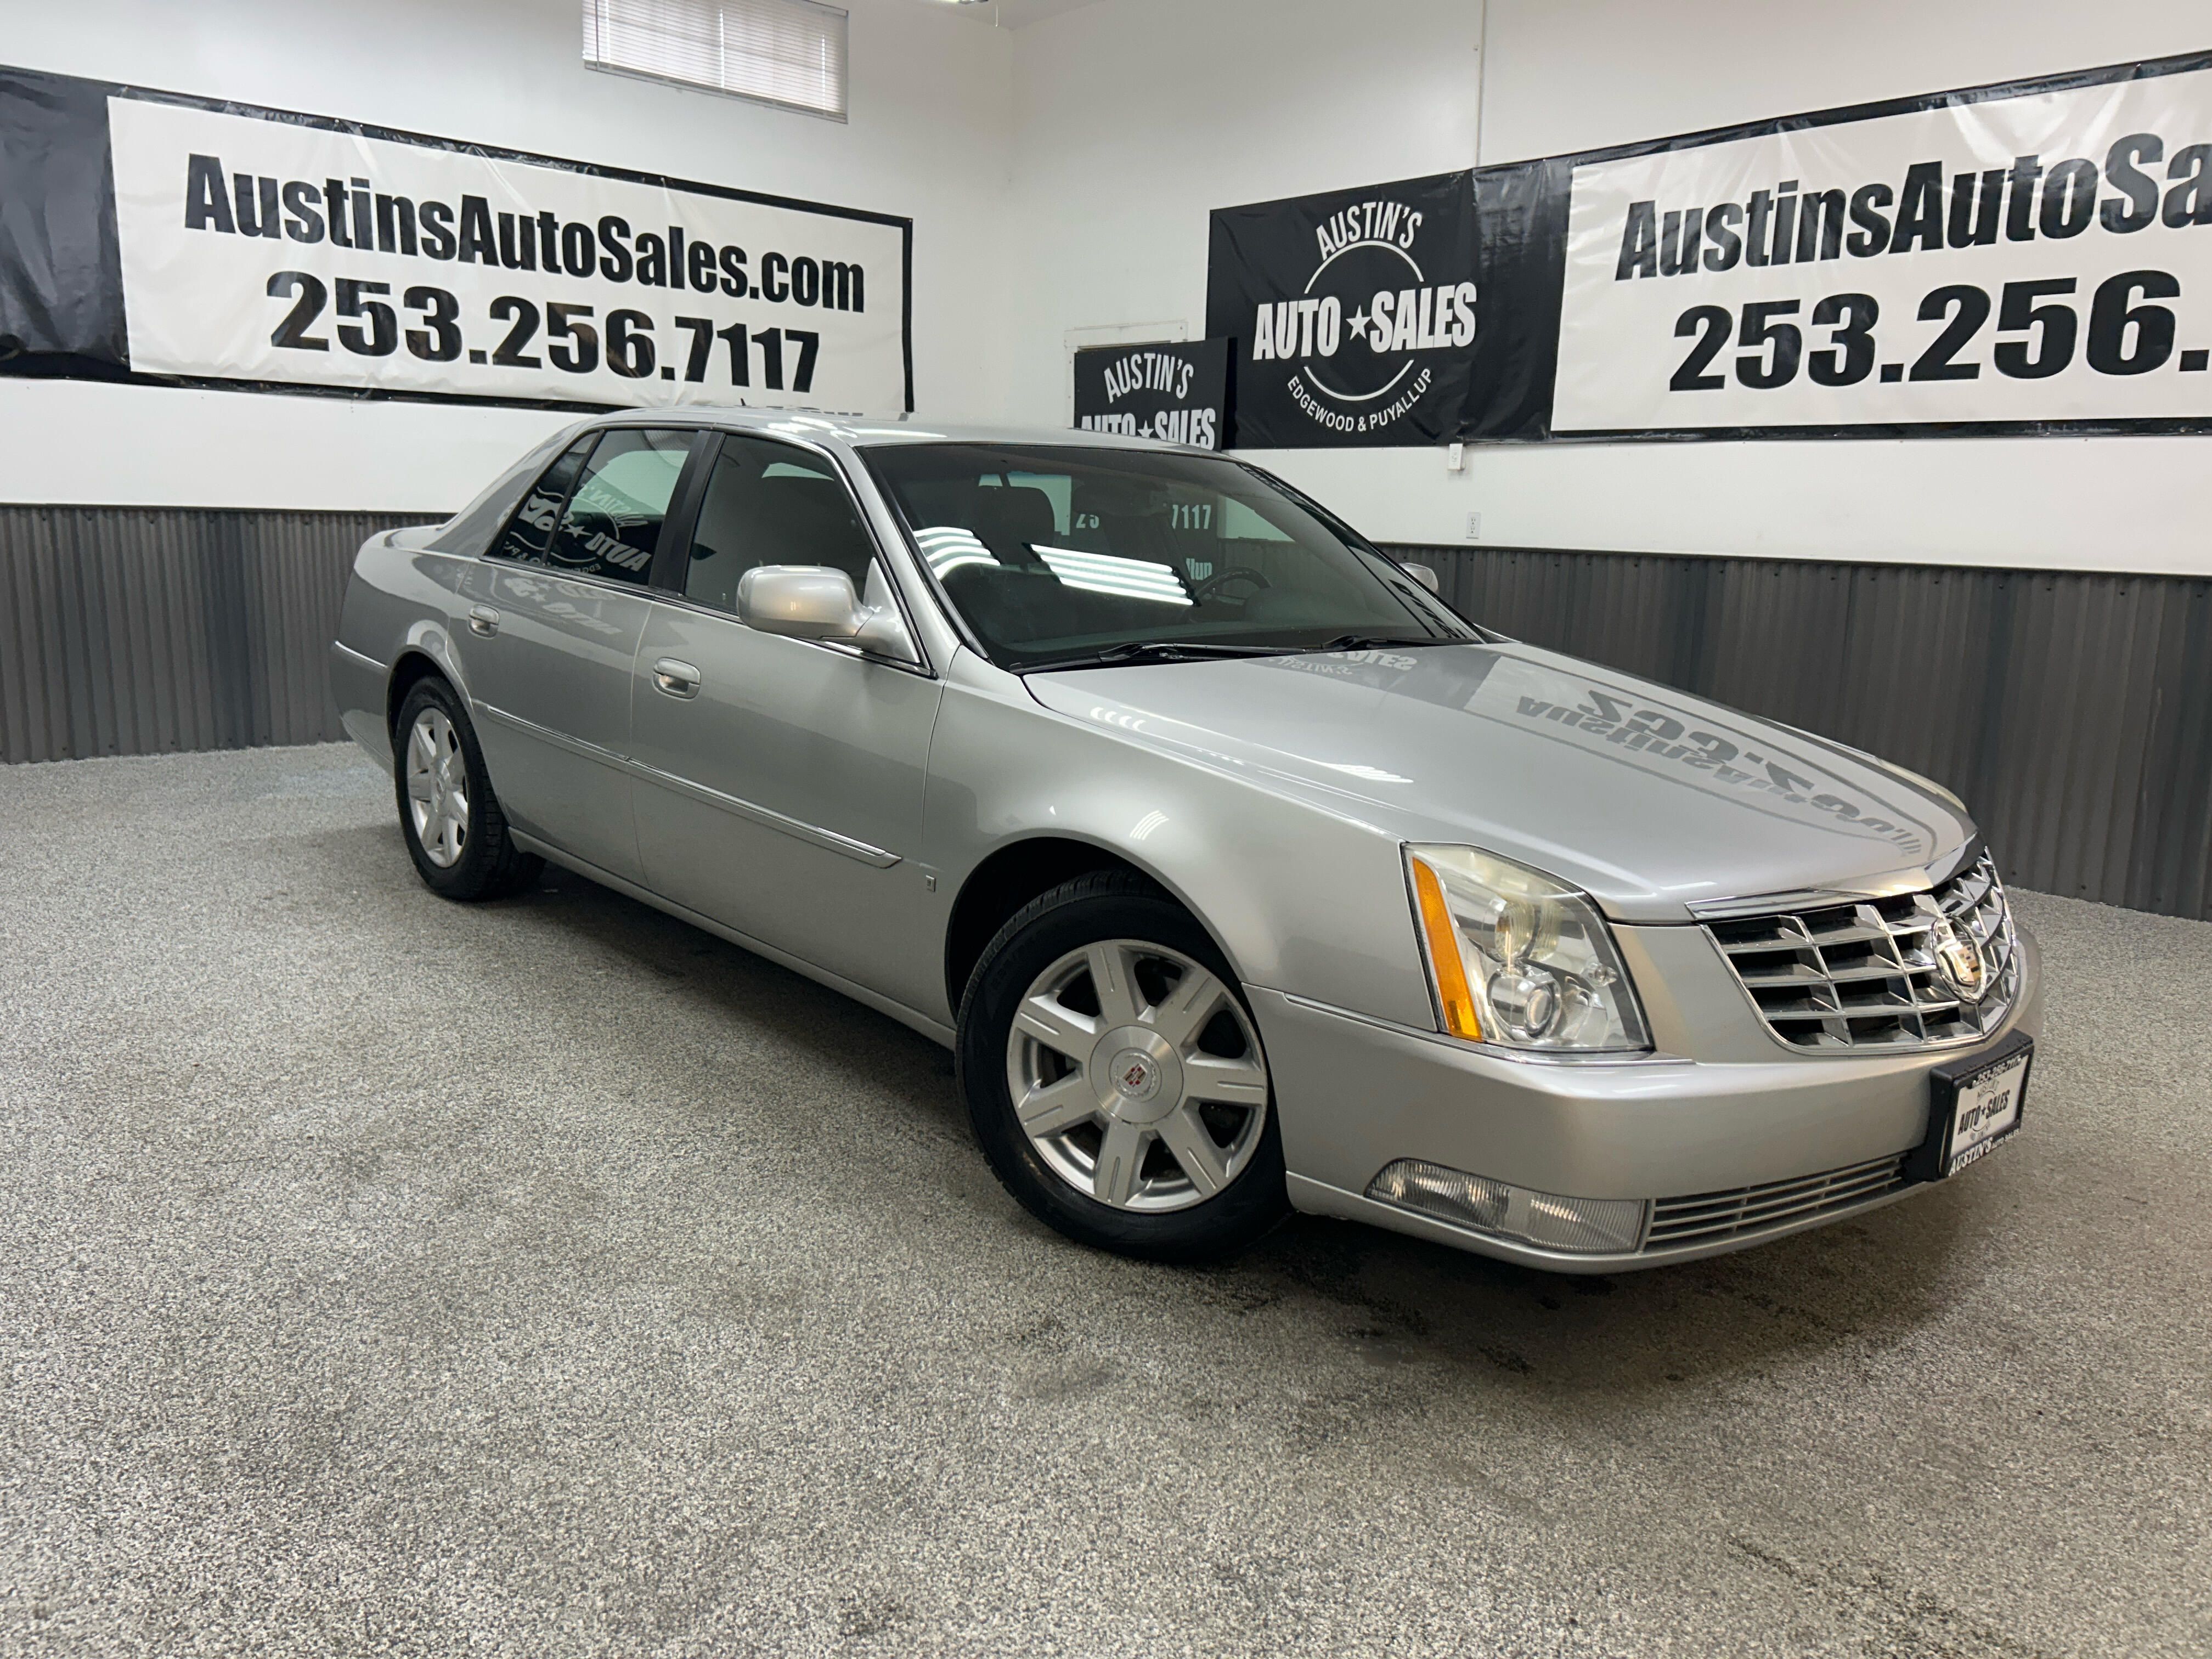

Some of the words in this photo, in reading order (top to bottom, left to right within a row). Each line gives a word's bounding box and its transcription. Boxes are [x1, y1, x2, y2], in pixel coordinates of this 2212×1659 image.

[185, 154, 864, 313] AustinsAutoSales.com
[1316, 201, 1423, 260] AUSTIN'S
[267, 272, 820, 393] 253.256.7117
[1252, 296, 1341, 360] AUTO
[1369, 282, 1477, 353] SALES
[1669, 270, 2209, 392] 253.256.
[1104, 352, 1194, 403] AUSTIN'S
[1288, 376, 1355, 432] EDGEWOOD
[1357, 416, 1367, 432] &
[1369, 368, 1431, 430] PUYALLUP
[1155, 408, 1216, 450] SALES
[1957, 1105, 1981, 1135] AUTO
[1986, 1089, 2010, 1120] SALES
